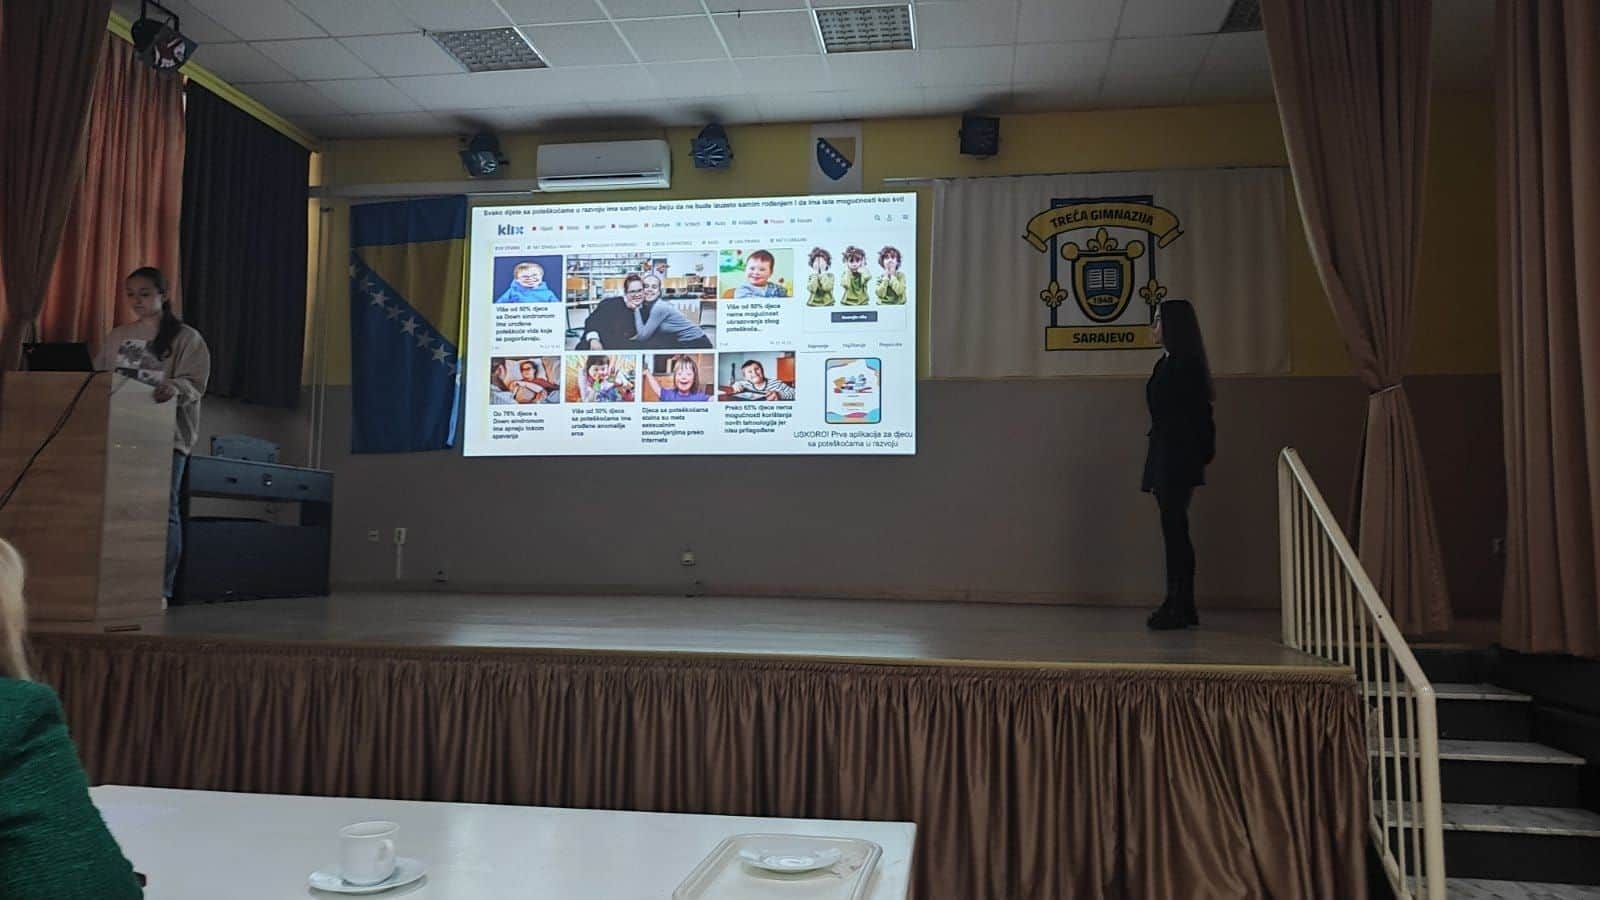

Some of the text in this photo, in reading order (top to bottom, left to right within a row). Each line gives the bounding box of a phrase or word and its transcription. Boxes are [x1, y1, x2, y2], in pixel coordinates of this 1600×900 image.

[1050, 209, 1154, 228] TREĆA GIMNAZIJA
[498, 224, 524, 236] klix
[1072, 332, 1134, 344] SARAJEVO
[849, 430, 881, 438] aplikacija
[894, 430, 913, 439] djecu
[818, 440, 864, 448] poteškoćama
